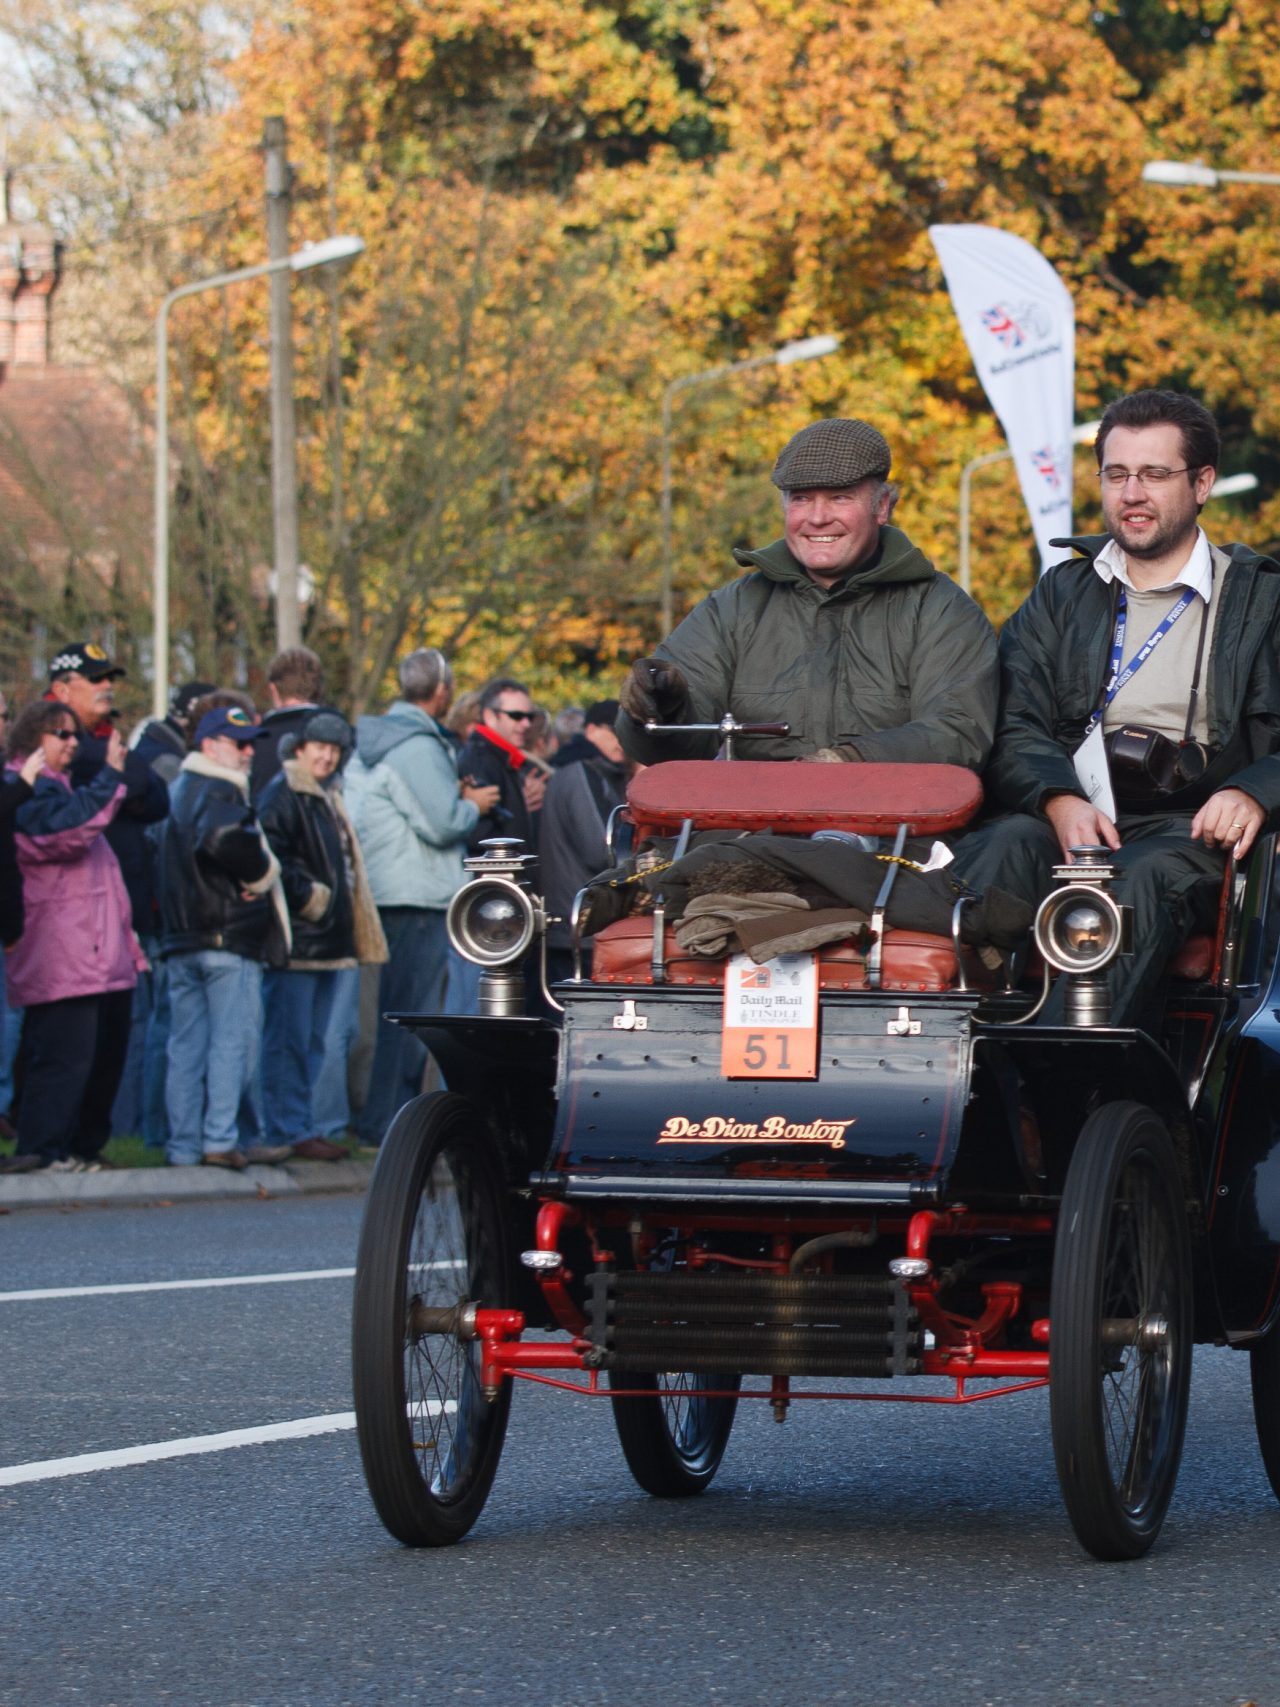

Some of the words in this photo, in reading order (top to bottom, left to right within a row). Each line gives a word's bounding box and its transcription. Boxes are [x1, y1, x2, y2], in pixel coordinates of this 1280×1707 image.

[740, 995, 772, 1007] Daily
[775, 996, 802, 1006] Mail
[751, 1009, 800, 1018] TINDLE
[743, 1034, 791, 1070] 51
[757, 1116, 857, 1149] Bouton
